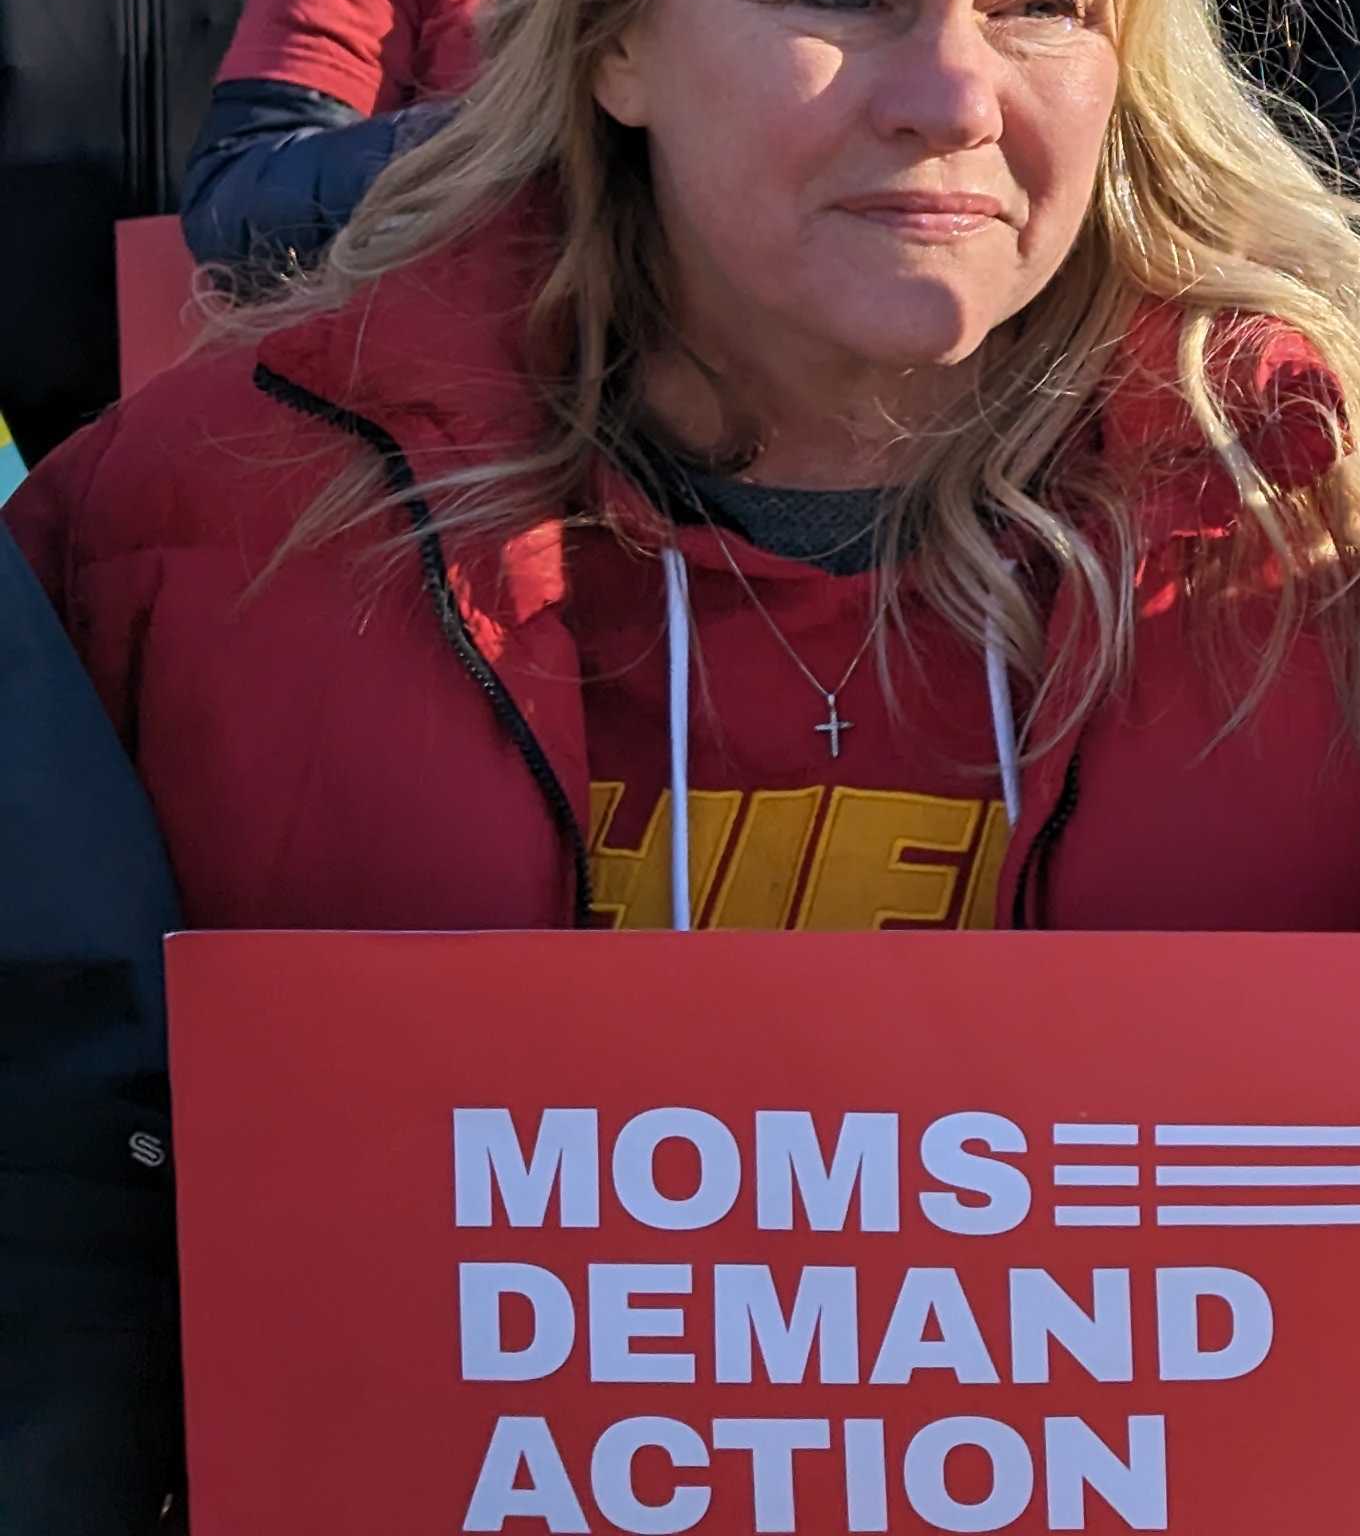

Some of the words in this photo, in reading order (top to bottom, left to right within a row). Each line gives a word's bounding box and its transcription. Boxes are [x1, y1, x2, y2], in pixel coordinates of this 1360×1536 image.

[452, 1106, 1033, 1236] MOMS
[458, 1262, 1274, 1385] DEMAND
[462, 1414, 1169, 1535] ACTION
